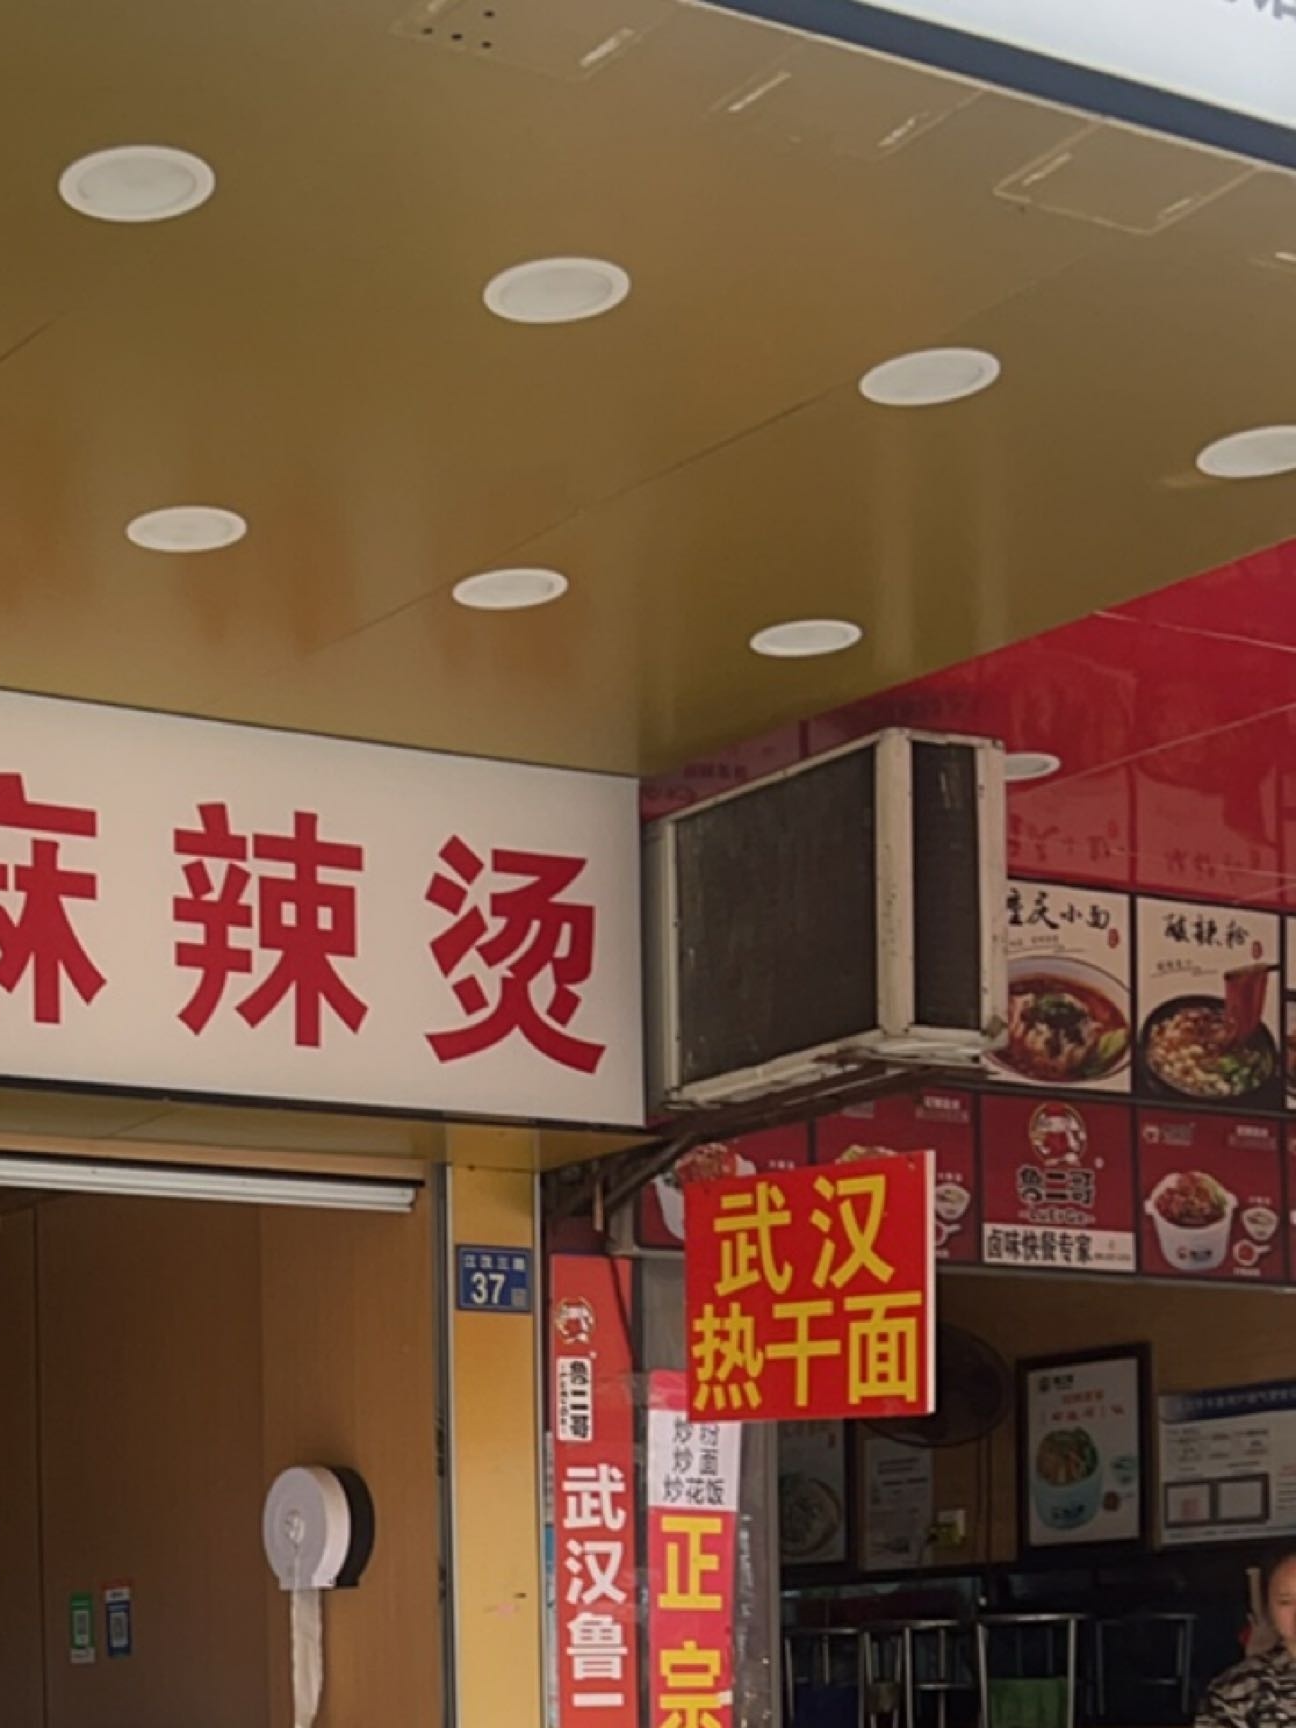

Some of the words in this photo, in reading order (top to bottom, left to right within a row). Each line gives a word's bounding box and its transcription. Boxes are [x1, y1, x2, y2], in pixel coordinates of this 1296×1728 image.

[1018, 1165, 1094, 1206] 鲁二哥
[713, 1173, 896, 1298] 武汉
[470, 1271, 506, 1305] 37
[691, 1289, 923, 1412] 热干面
